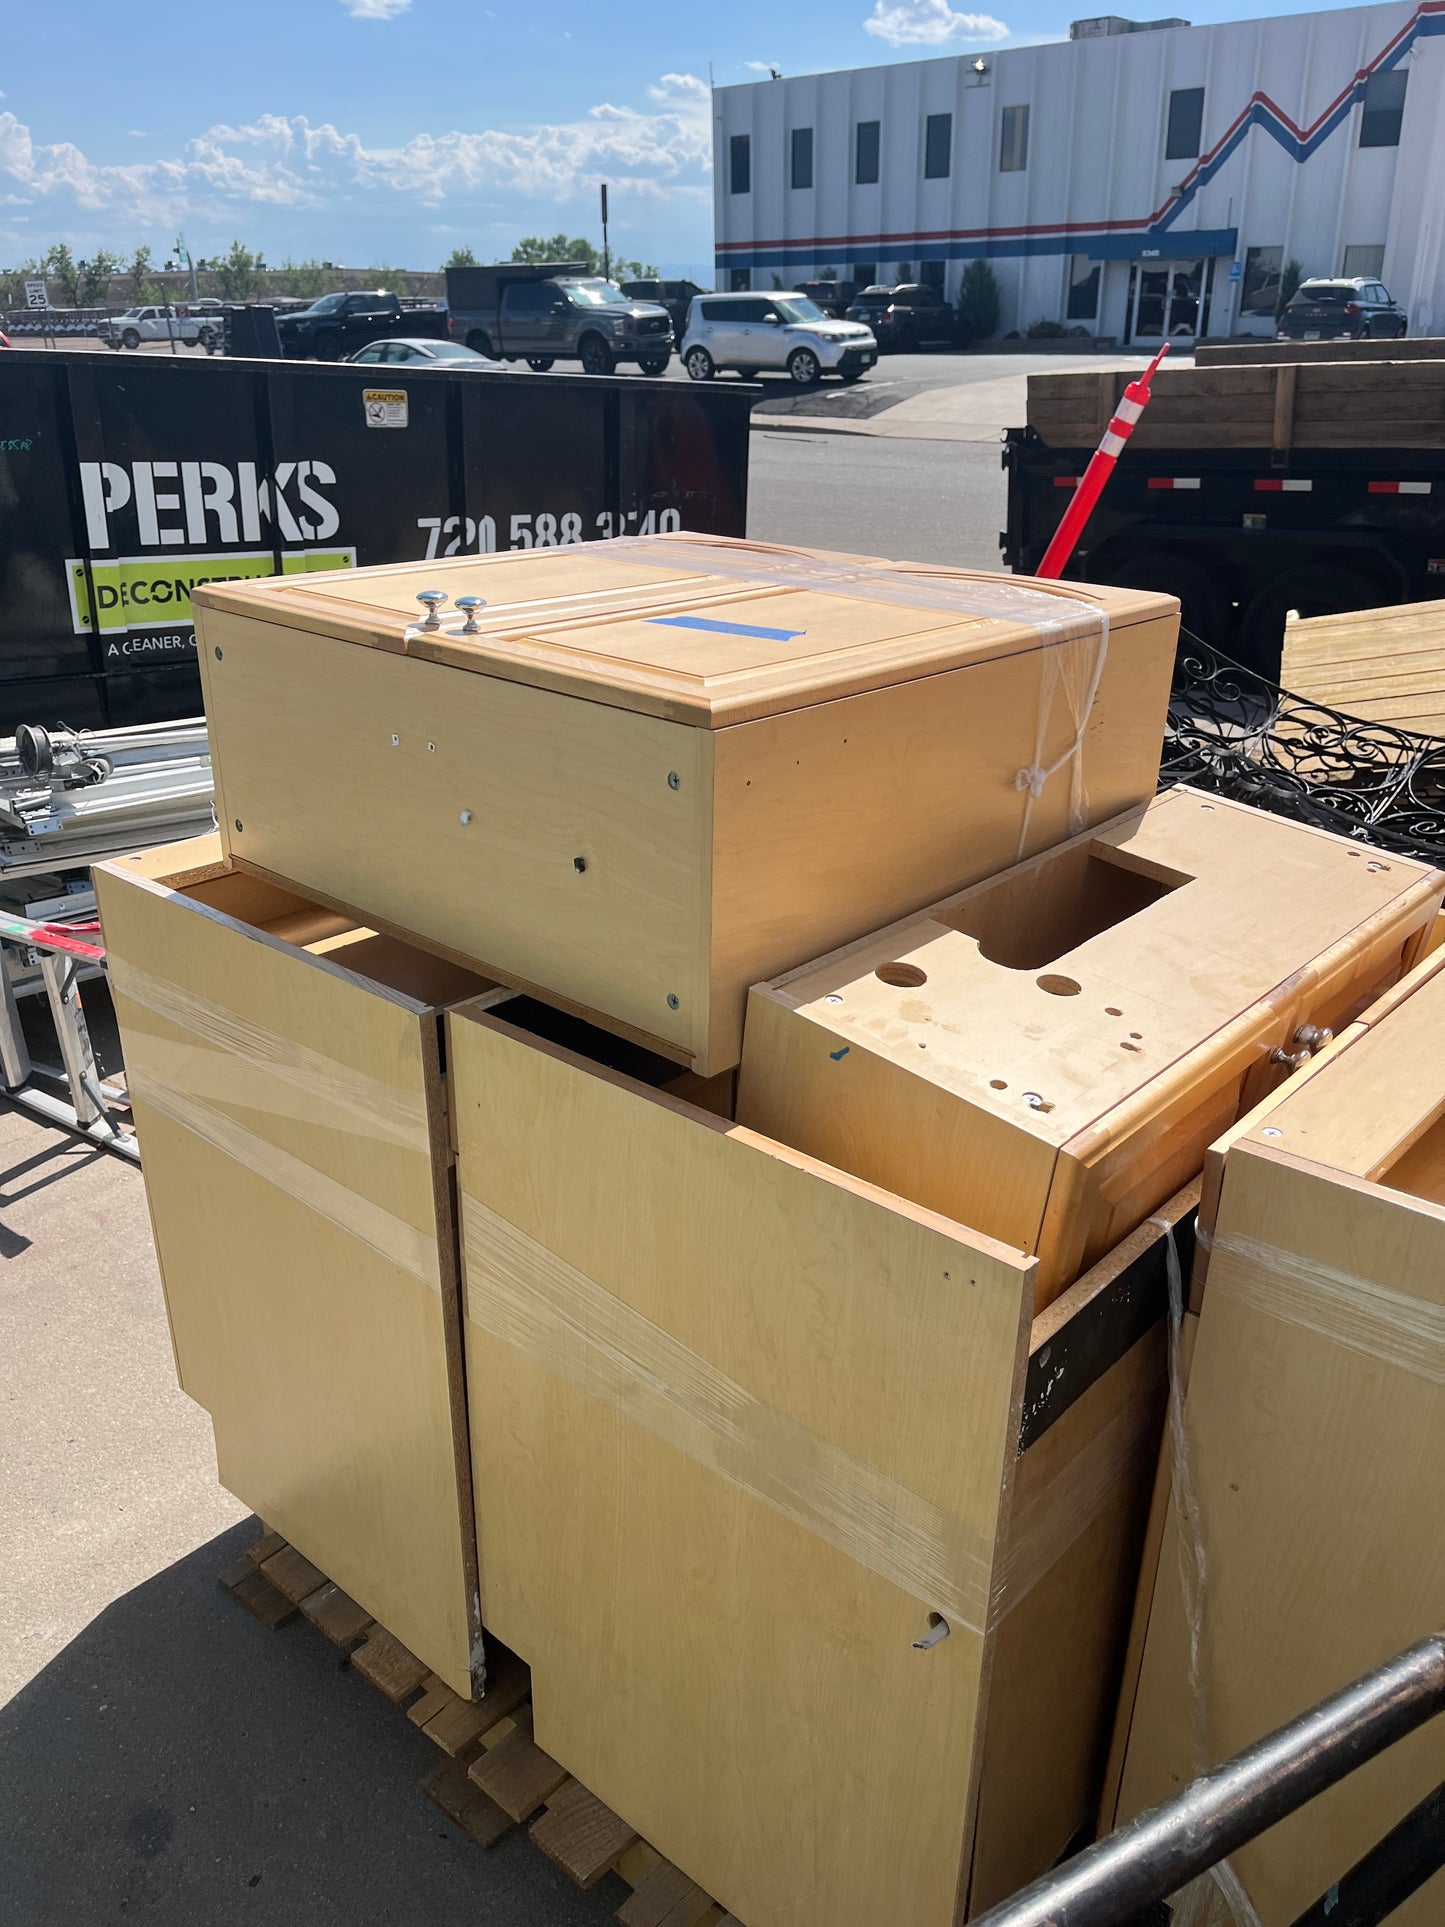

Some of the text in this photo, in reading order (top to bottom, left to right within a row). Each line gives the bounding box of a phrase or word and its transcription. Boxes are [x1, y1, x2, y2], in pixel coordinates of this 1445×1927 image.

[29, 294, 47, 305] 25
[371, 392, 405, 402] CAUTION
[79, 460, 340, 550] PERKS
[417, 514, 497, 561] 720
[510, 512, 583, 550] 588
[107, 643, 120, 656] A
